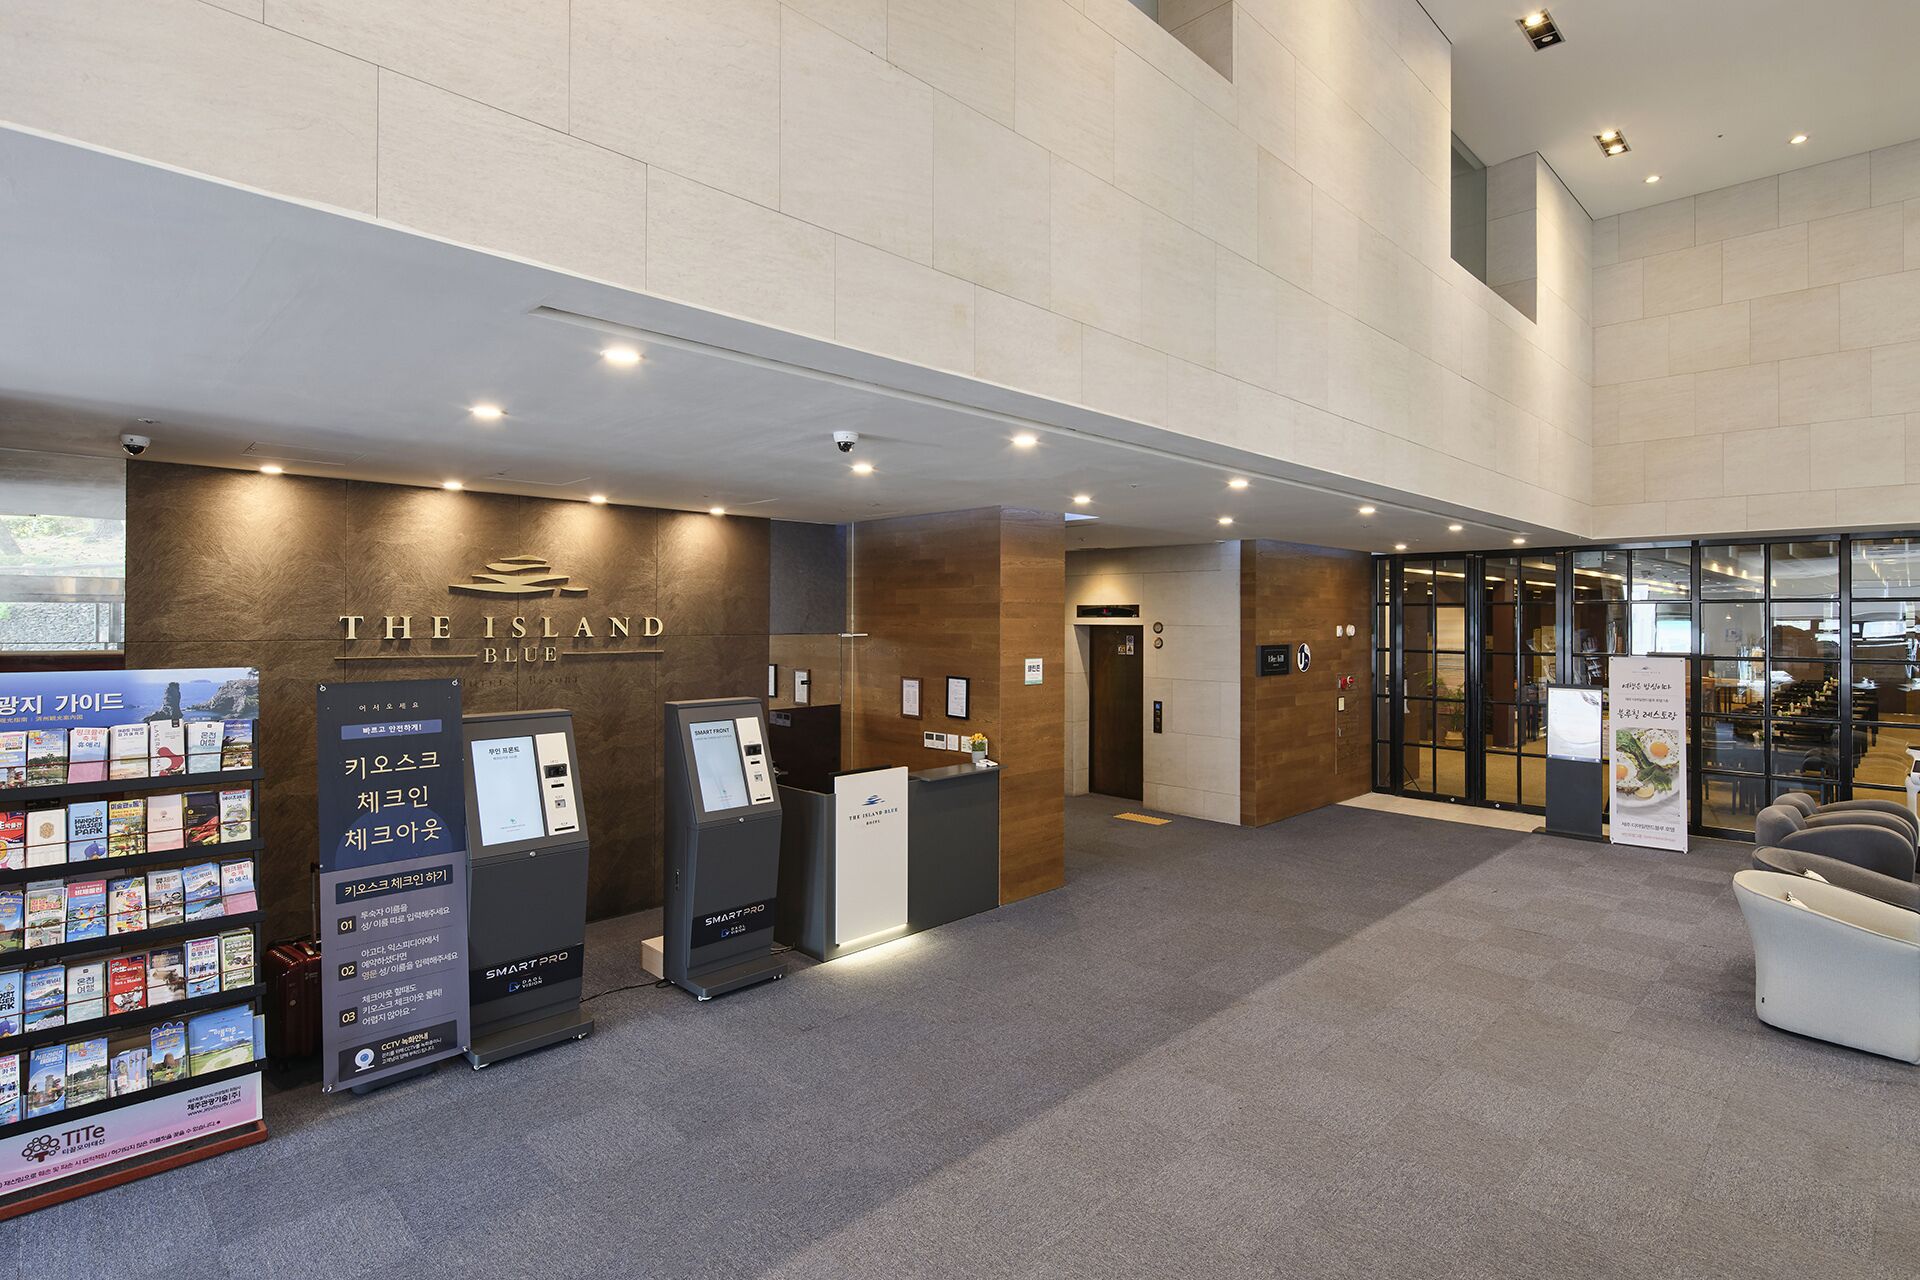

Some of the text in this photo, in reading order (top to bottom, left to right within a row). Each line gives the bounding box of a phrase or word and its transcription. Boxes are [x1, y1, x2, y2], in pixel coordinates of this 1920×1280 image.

[339, 616, 664, 639] THE ISLAND
[483, 646, 557, 663] BLUE
[55, 693, 124, 713] 가이드
[359, 702, 420, 712] 어서오세요
[1642, 710, 1678, 721] 레스토랑
[362, 723, 422, 735] 빠르고 안전하게!
[694, 728, 712, 736] SMART
[345, 751, 440, 780] 키오스크
[357, 785, 428, 814] 체크인
[862, 810, 883, 819] ISLAND
[884, 807, 898, 815] BLUE
[75, 827, 103, 836] PARK
[345, 818, 442, 851] 체크아웃
[344, 869, 447, 898] 키오스크 체크인 하기
[361, 903, 408, 920] 투숙자 이름을
[374, 917, 389, 928] 이름
[390, 915, 405, 925] 따로
[407, 906, 450, 921] 입력해주세요
[340, 920, 353, 931] 01
[387, 934, 439, 951] 익스피디아에서
[361, 952, 407, 968] 예약하셨다면
[391, 962, 414, 973] 이름을
[415, 951, 458, 968] 입력해주세요
[341, 965, 355, 977] 02
[77, 985, 95, 994] 여행
[522, 979, 543, 989] VISION
[362, 984, 417, 1004] 체크아웃 할때도
[362, 1000, 393, 1015] 키오스크
[394, 994, 425, 1007] 체크아웃
[342, 1011, 356, 1023] 03
[362, 1013, 386, 1025] 어렵지
[381, 1039, 400, 1051] CCTV
[62, 1125, 105, 1147] TiTe
